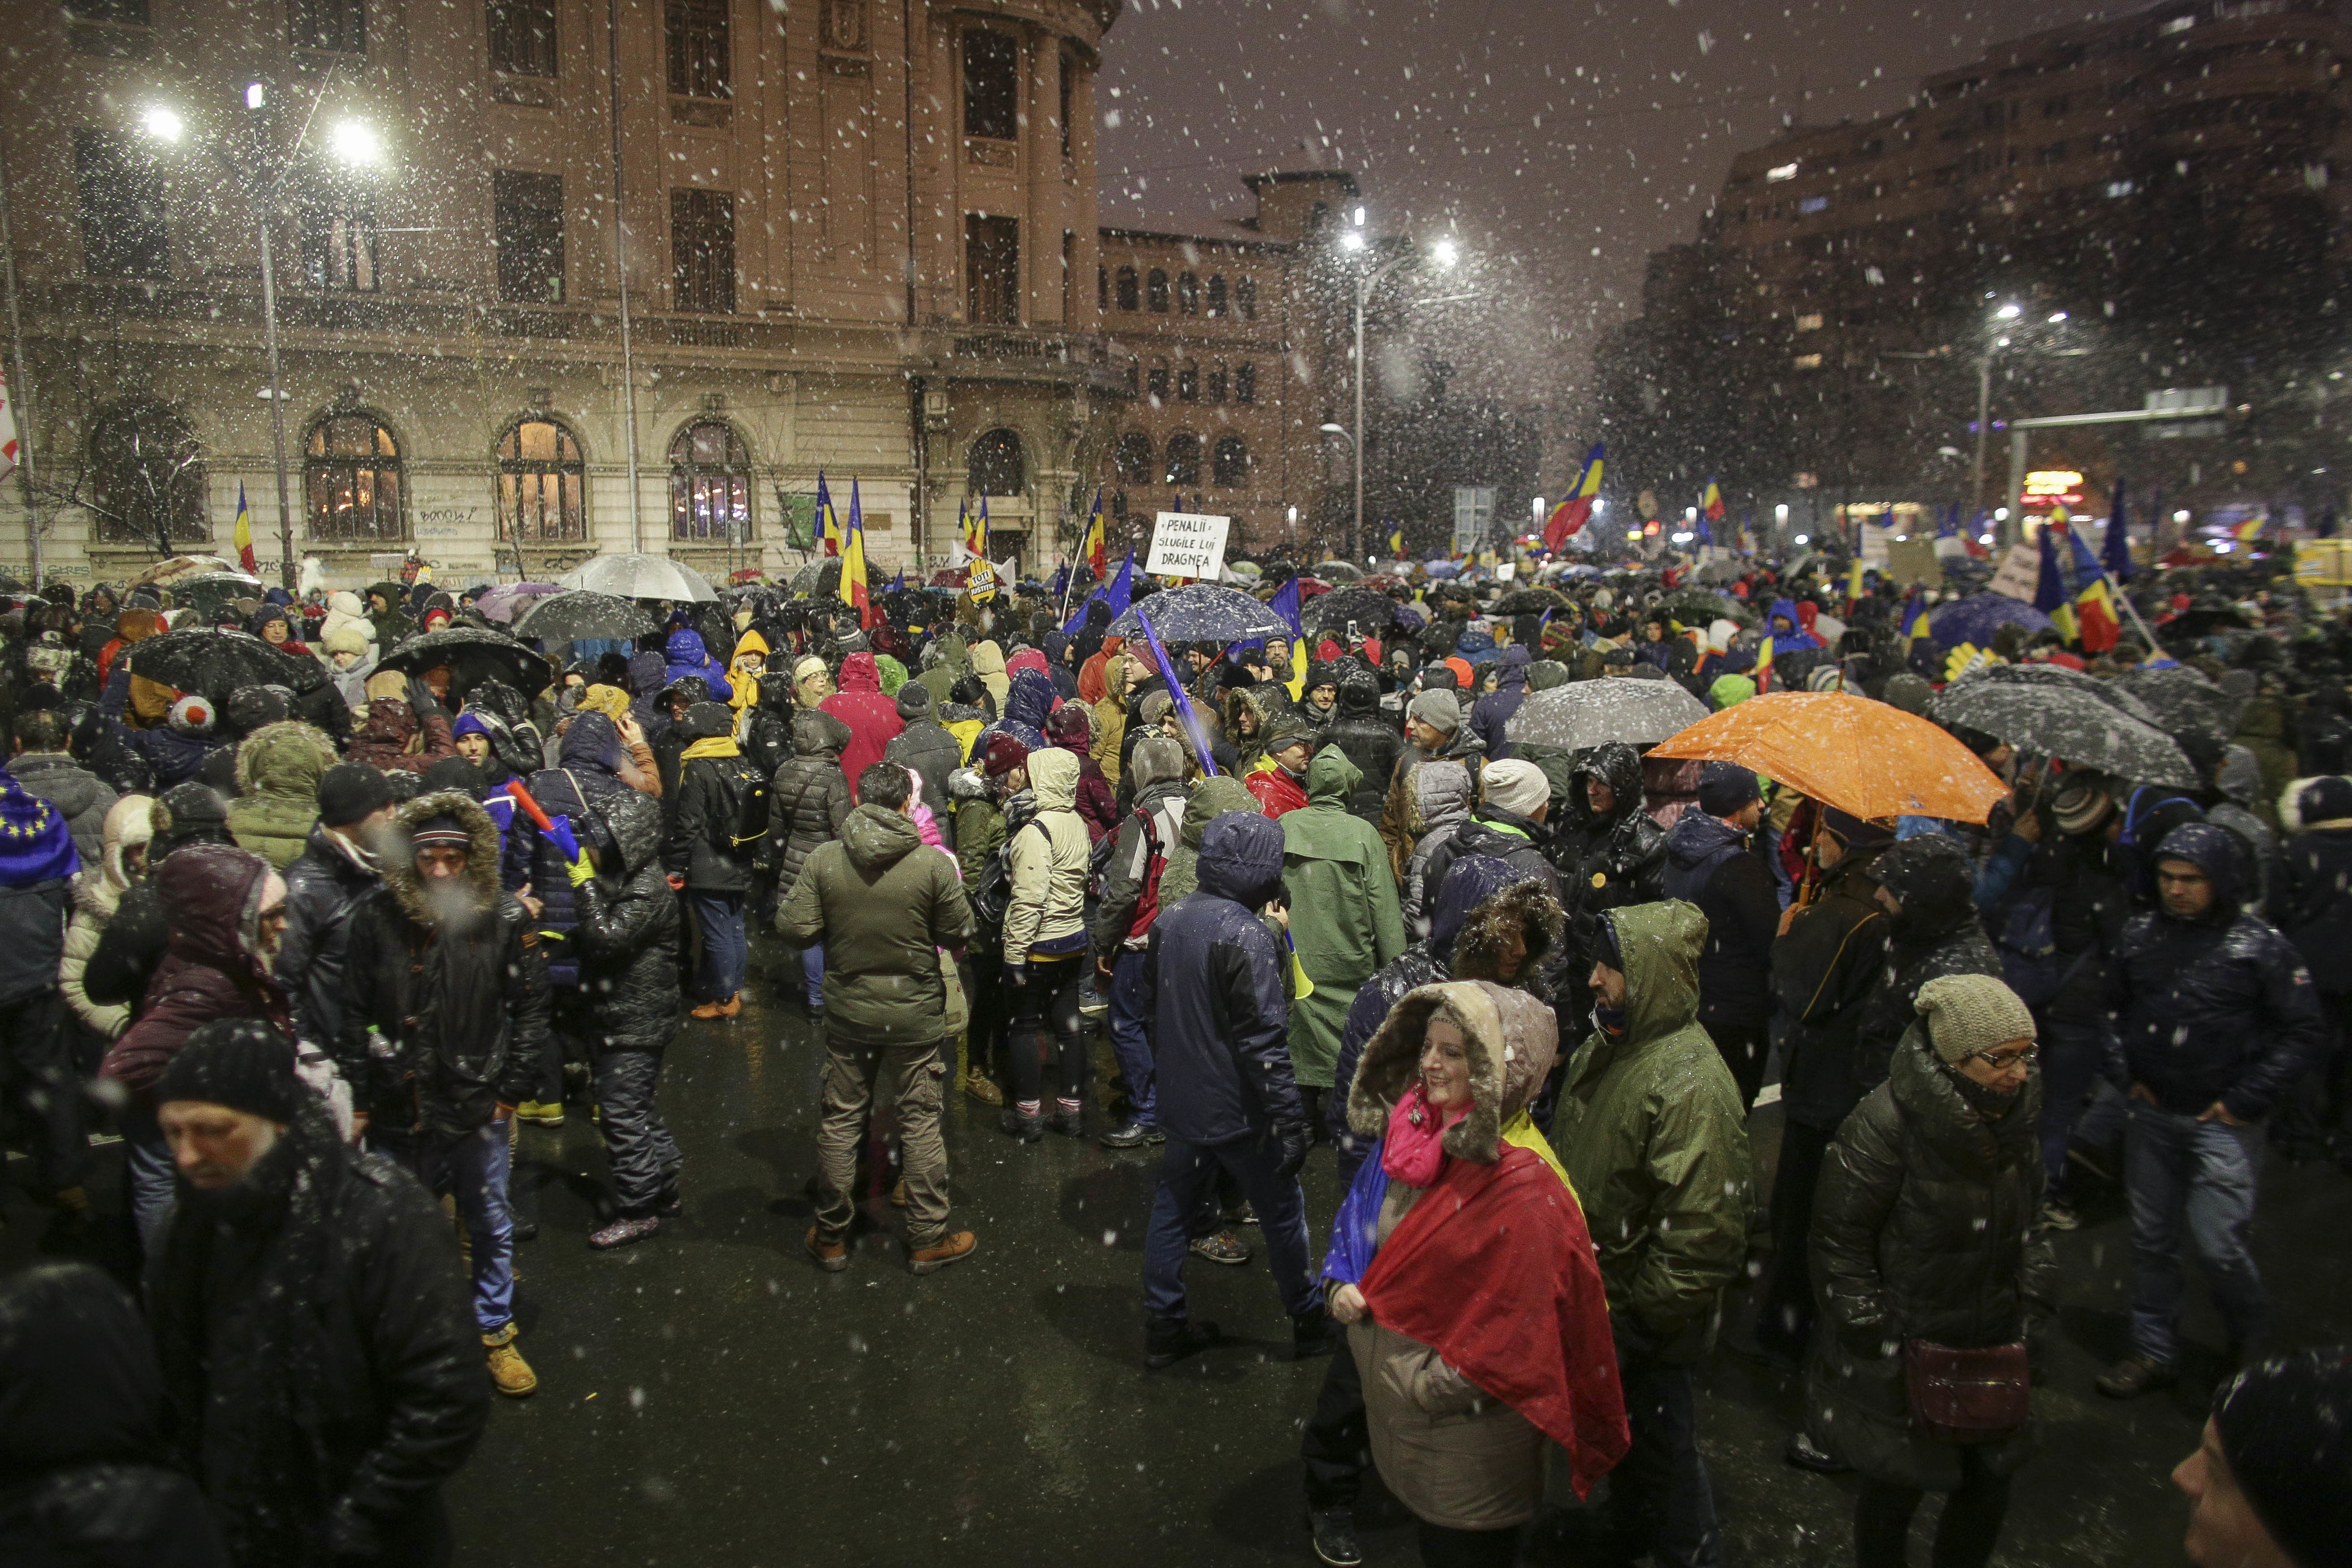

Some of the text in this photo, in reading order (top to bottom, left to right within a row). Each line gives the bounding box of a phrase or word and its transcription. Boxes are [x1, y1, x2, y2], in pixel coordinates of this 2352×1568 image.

[1159, 536, 1216, 550] SLUGILE LUI
[1161, 553, 1210, 567] DRAGNEA
